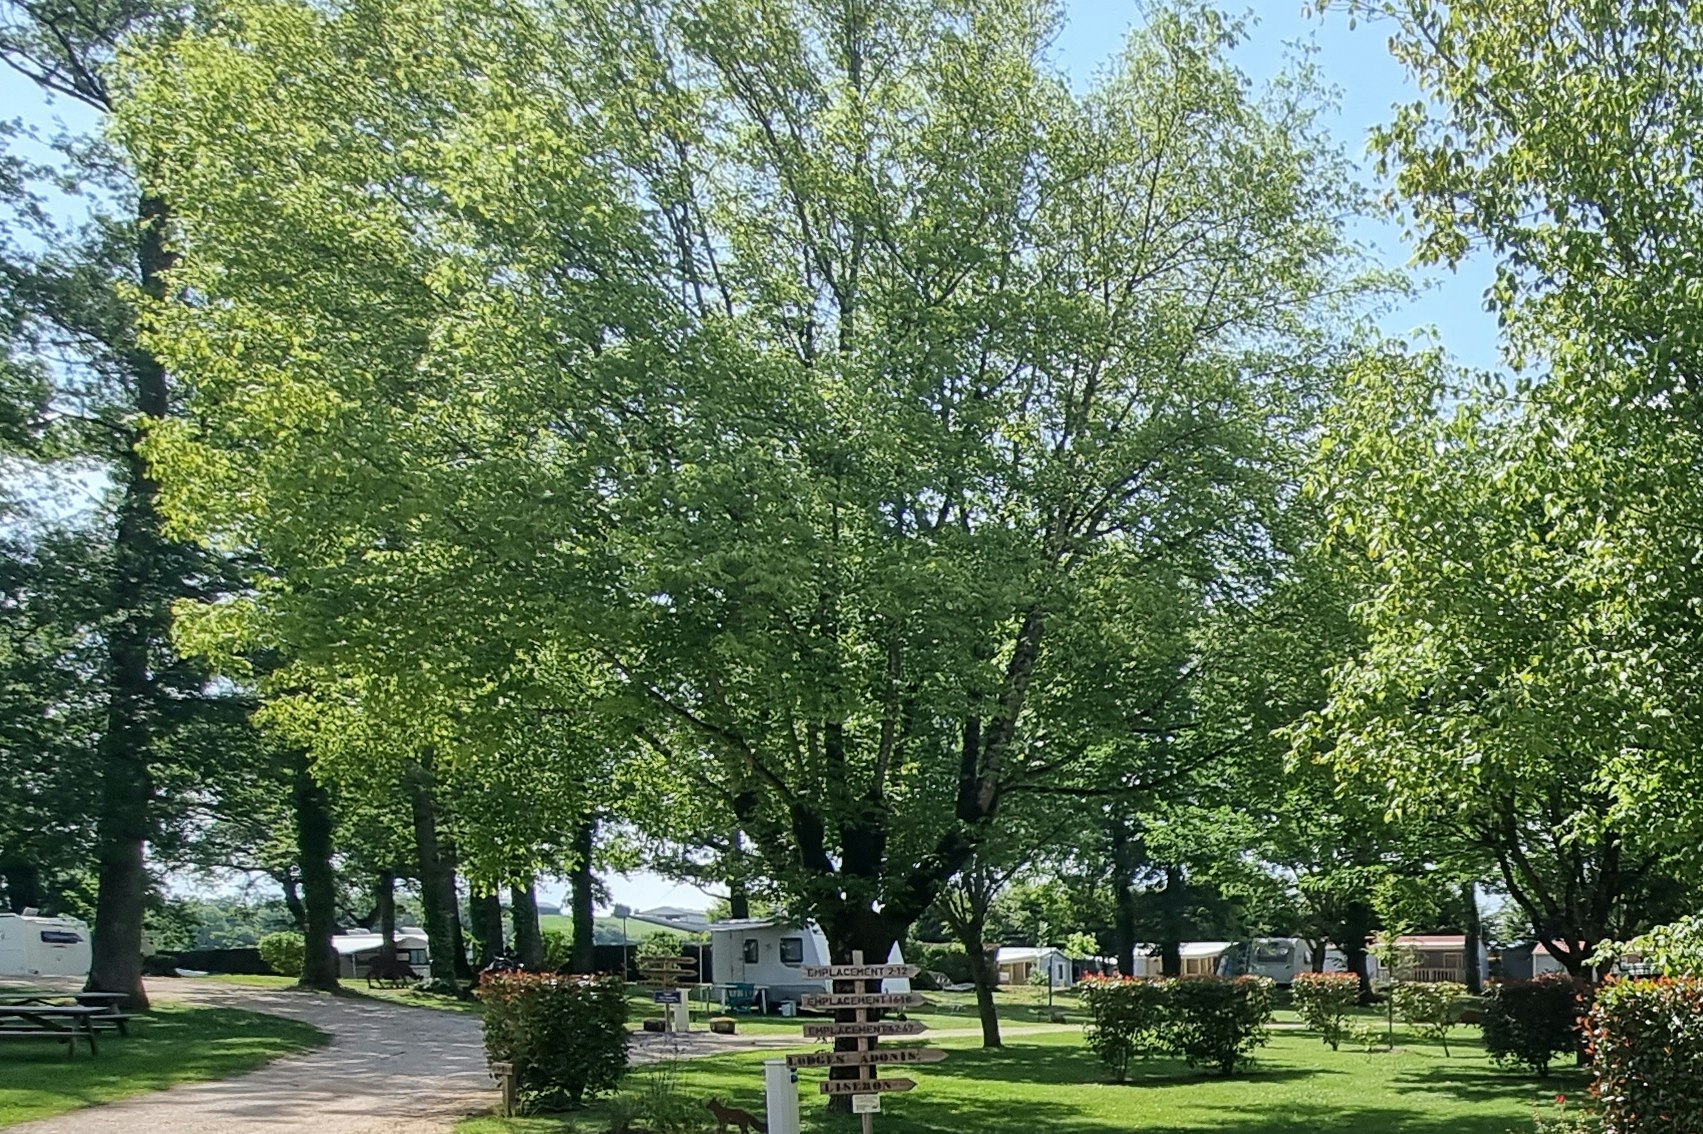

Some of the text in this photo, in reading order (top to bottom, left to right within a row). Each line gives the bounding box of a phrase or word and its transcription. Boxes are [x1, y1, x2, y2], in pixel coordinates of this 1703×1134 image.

[807, 967, 884, 977] EMPLACEMENT
[807, 995, 886, 1005] EMPLACEMENT
[808, 1024, 886, 1035] EMPLACEMENT
[788, 1054, 846, 1066] LODGES
[824, 1082, 892, 1093] LISERON
